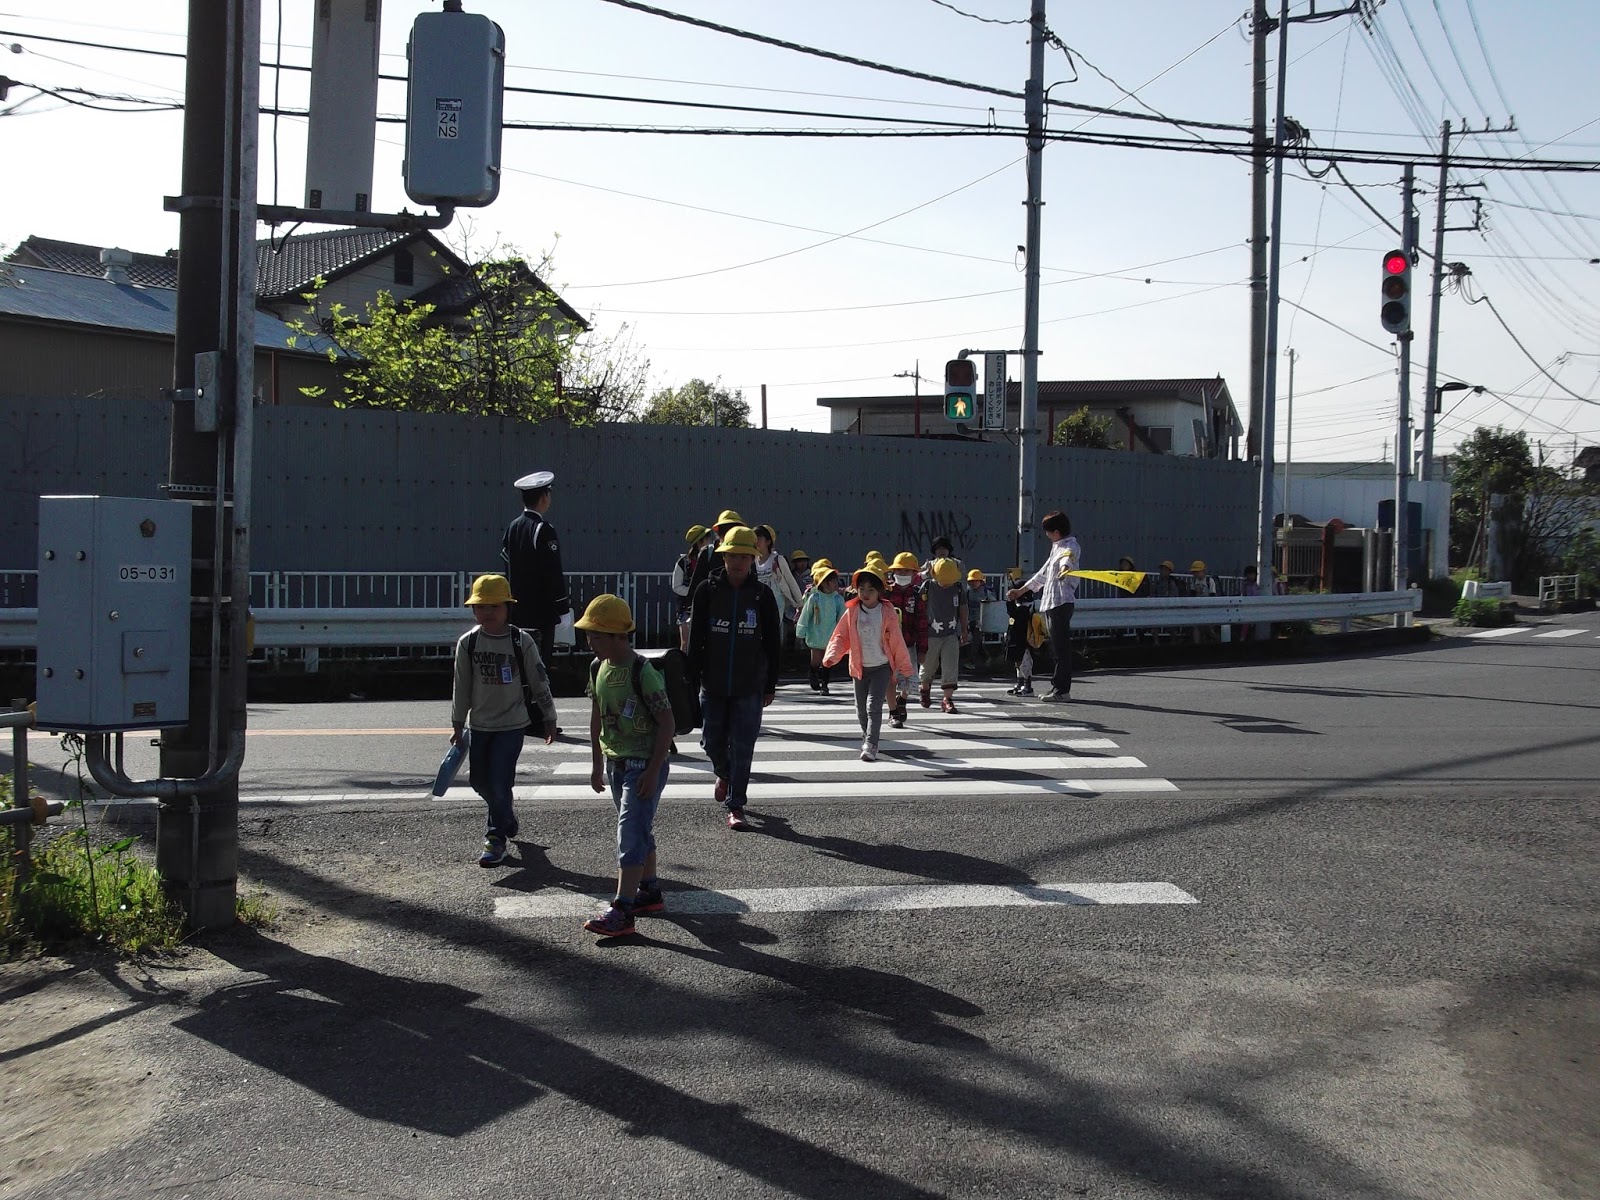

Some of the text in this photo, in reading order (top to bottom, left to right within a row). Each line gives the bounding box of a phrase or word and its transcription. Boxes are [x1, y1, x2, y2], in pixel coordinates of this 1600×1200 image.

[440, 112, 457, 124] 24
[438, 126, 457, 138] NS
[987, 381, 995, 426] おしてください
[120, 567, 175, 580] 05-031
